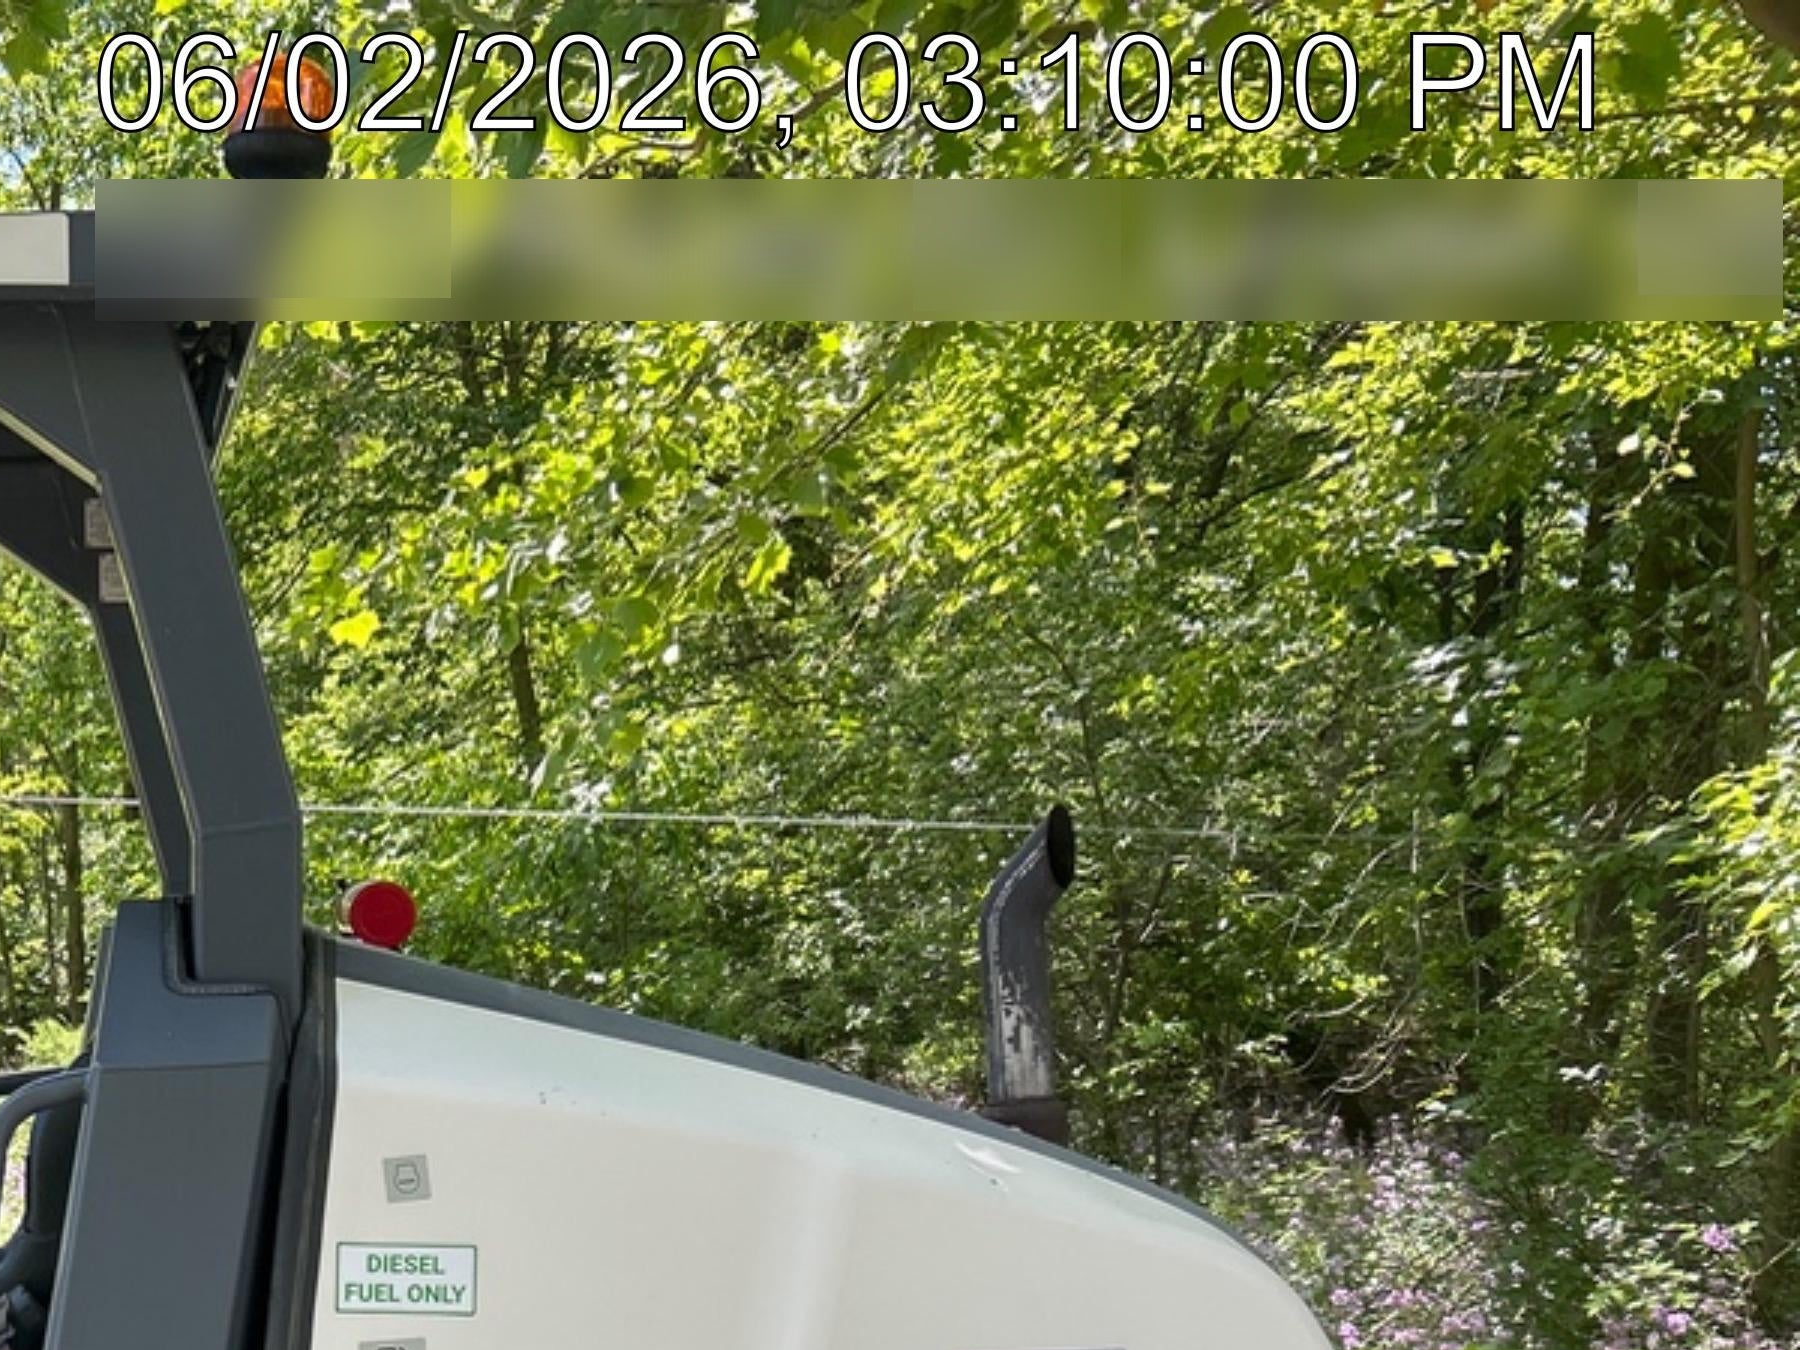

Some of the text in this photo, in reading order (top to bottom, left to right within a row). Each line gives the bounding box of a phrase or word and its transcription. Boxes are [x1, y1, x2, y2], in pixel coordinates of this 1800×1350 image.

[366, 1254, 445, 1276] DIESEL
[344, 1283, 466, 1304] FUEL ONLY
